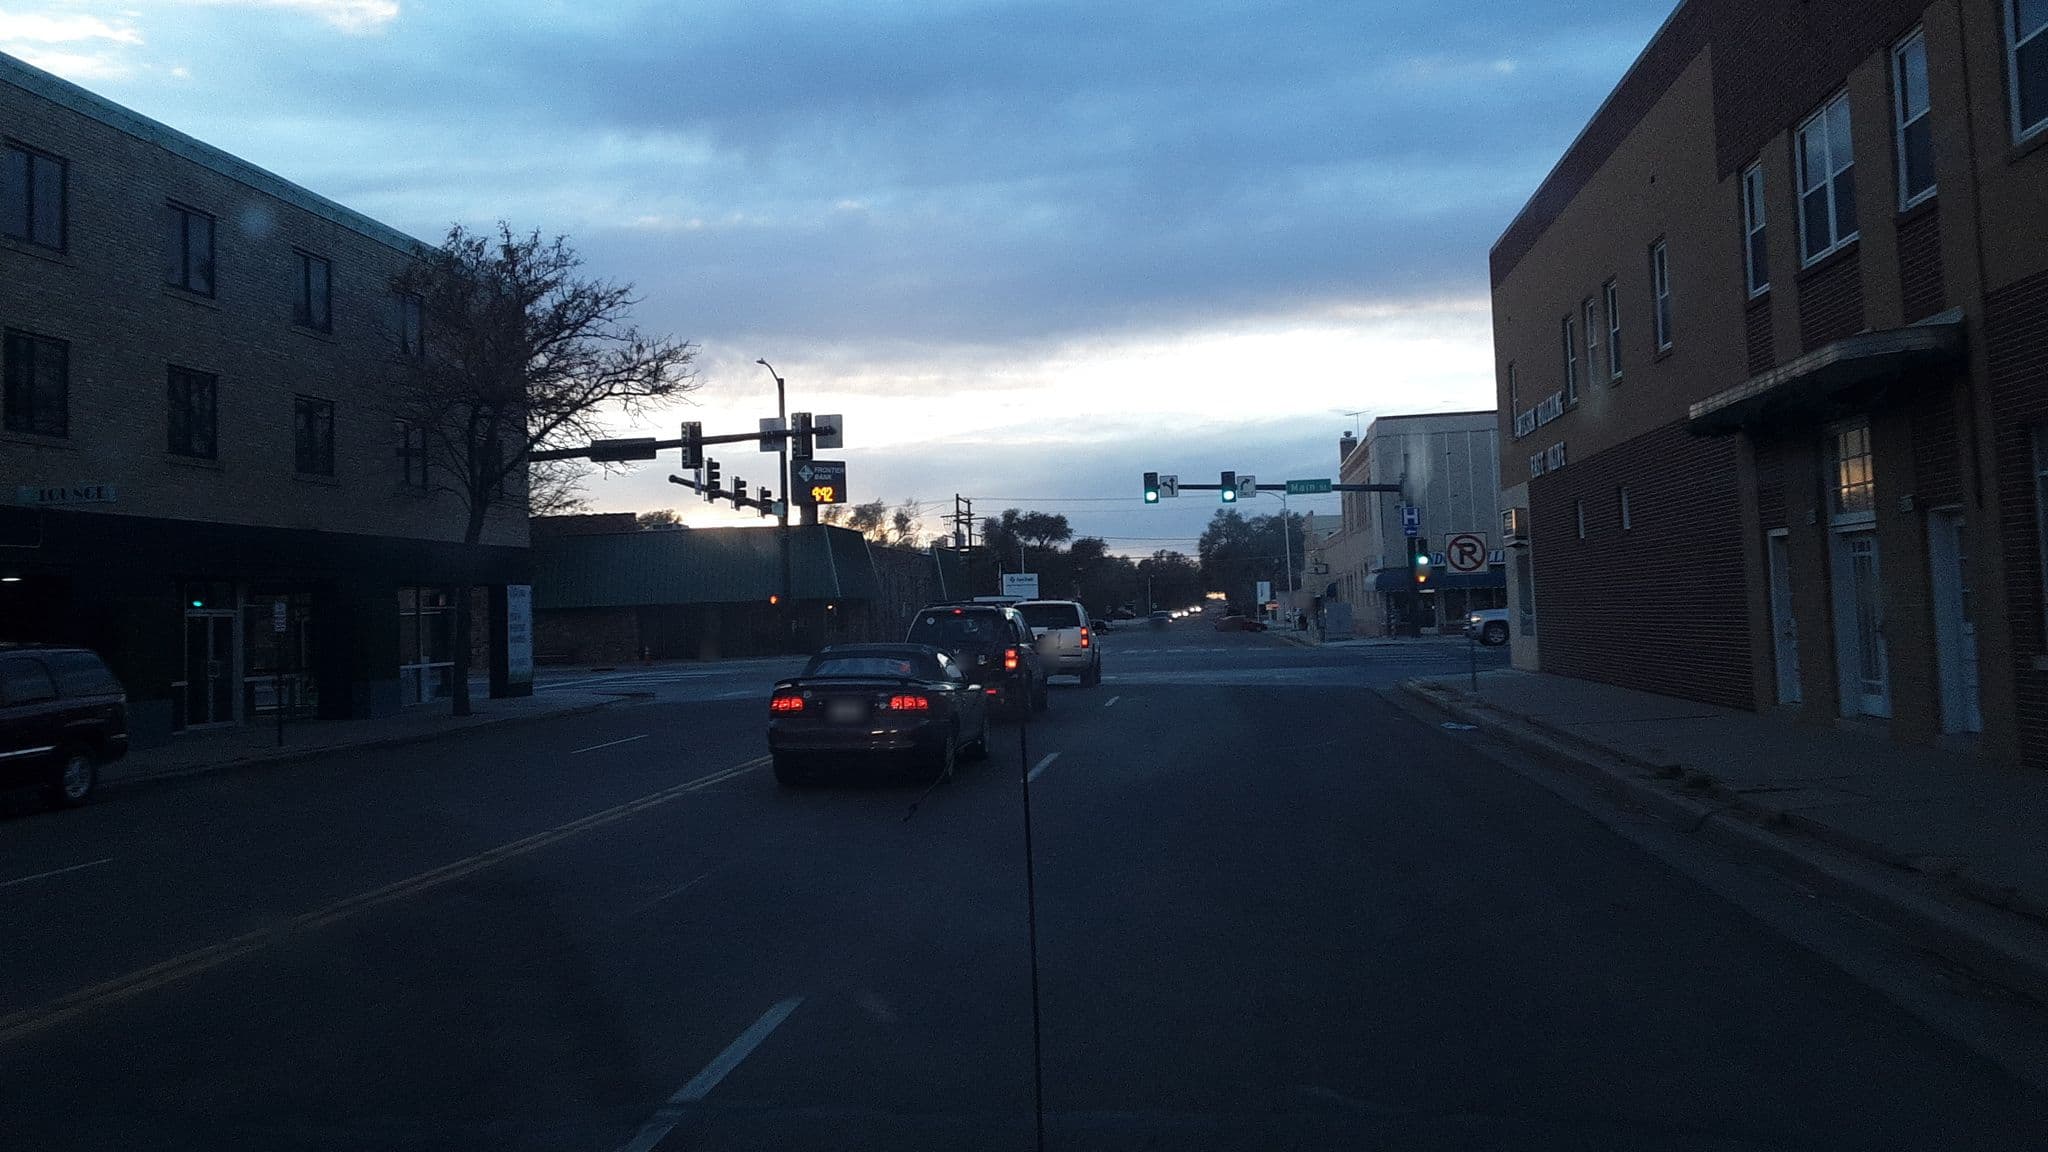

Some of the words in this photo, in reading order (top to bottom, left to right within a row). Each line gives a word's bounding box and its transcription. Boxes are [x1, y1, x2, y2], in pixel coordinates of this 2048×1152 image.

[814, 466, 845, 474] FRONTIER
[1290, 483, 1316, 492] Main
[1403, 508, 1420, 526] H
